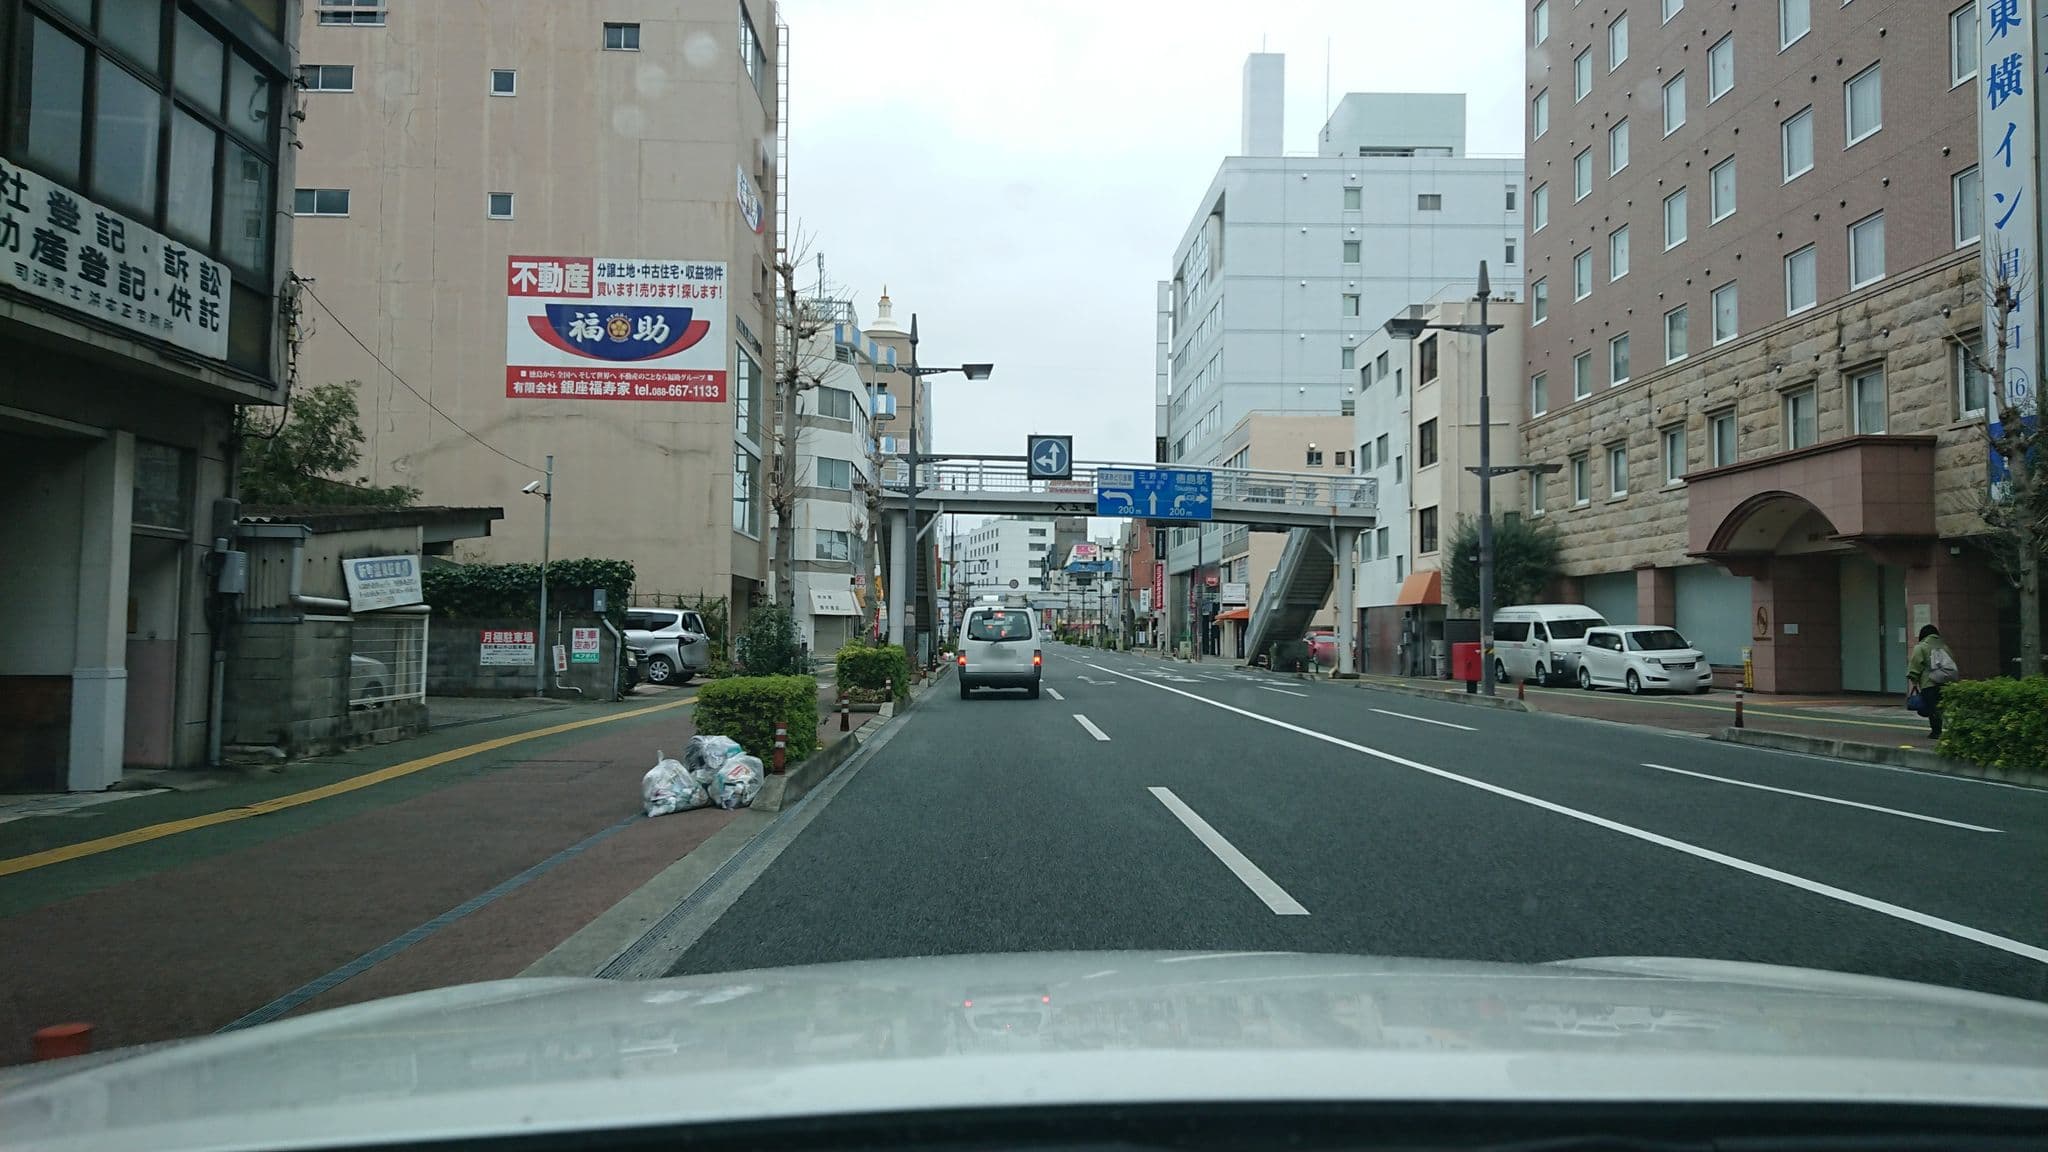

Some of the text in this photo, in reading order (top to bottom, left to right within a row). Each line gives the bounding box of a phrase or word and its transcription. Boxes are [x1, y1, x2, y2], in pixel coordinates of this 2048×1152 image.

[1986, 0, 2023, 230] 東横イン
[511, 261, 591, 294] 不動産
[597, 262, 723, 281] 分譲土地・中古住宅・収益物件
[568, 312, 671, 344] 福 助
[513, 381, 559, 394] 有限会社
[561, 380, 631, 396] 銀座福寿家
[2008, 378, 2026, 398] 16
[1176, 473, 1207, 486] 徳島駅
[483, 631, 534, 643] 月極駐車場
